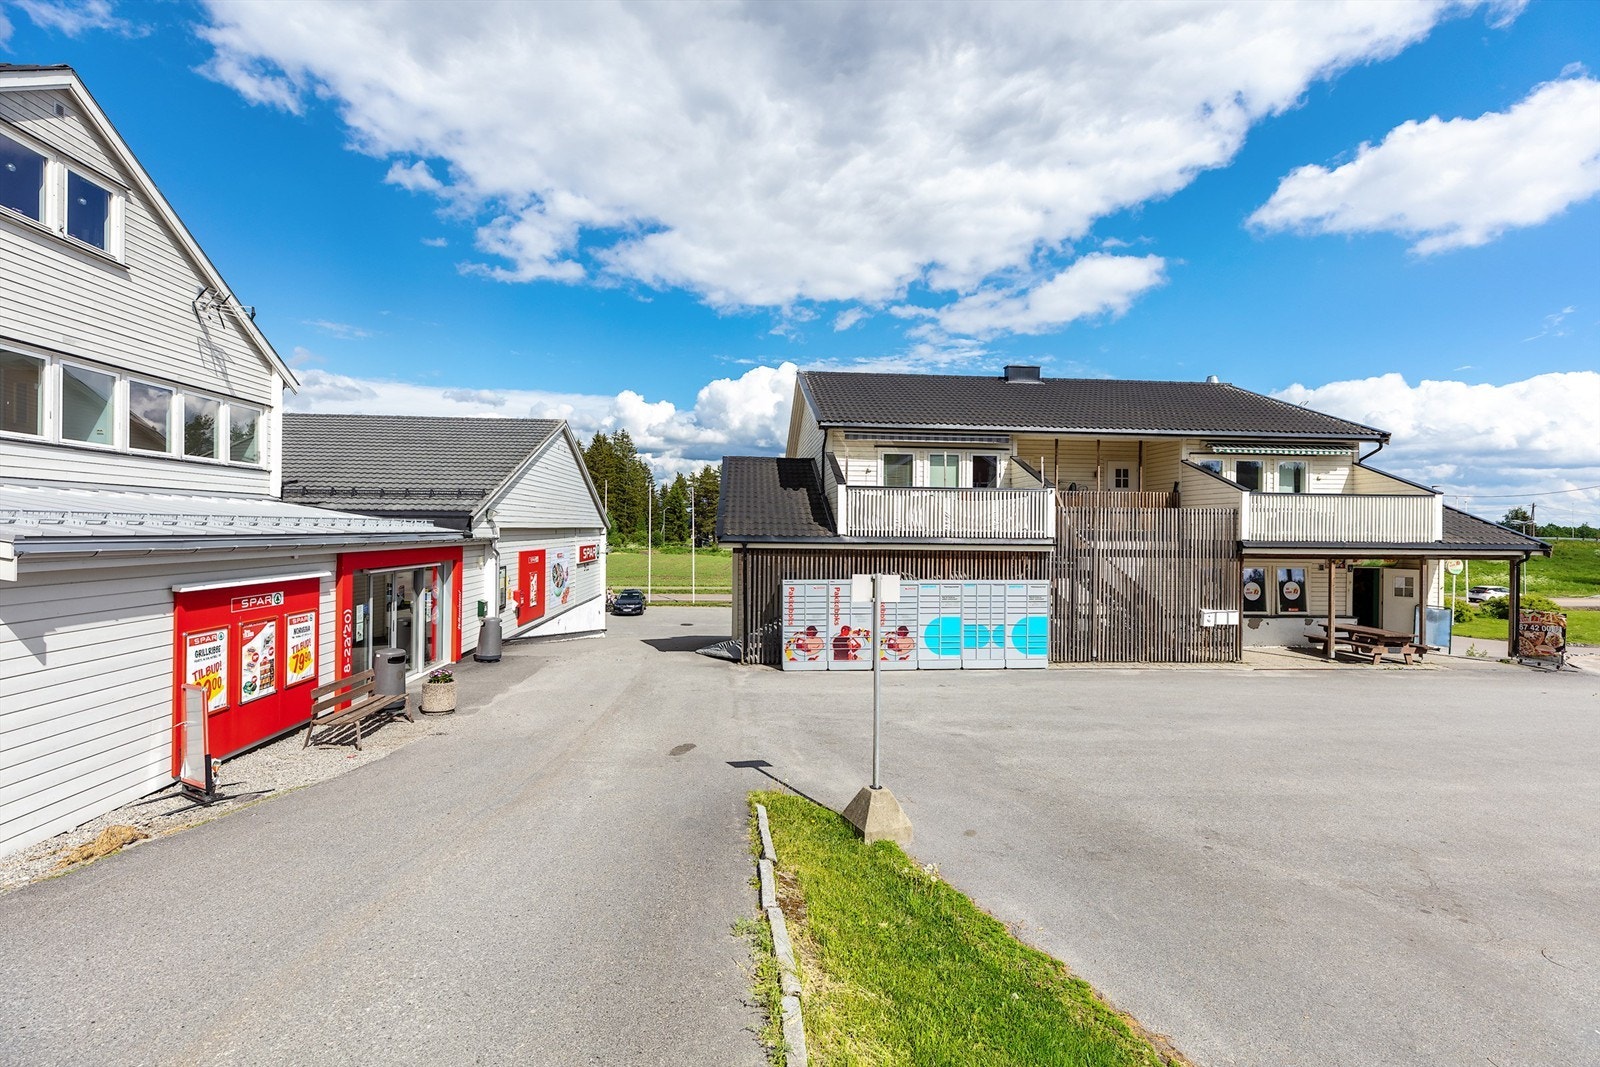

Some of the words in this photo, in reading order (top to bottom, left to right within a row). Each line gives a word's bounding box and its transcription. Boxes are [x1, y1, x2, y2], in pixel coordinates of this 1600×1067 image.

[583, 547, 596, 559] SPAR
[241, 594, 272, 608] SPAR
[194, 634, 217, 645] SPAR
[291, 638, 311, 654] TILBUD!
[192, 660, 222, 682] TILBUD!
